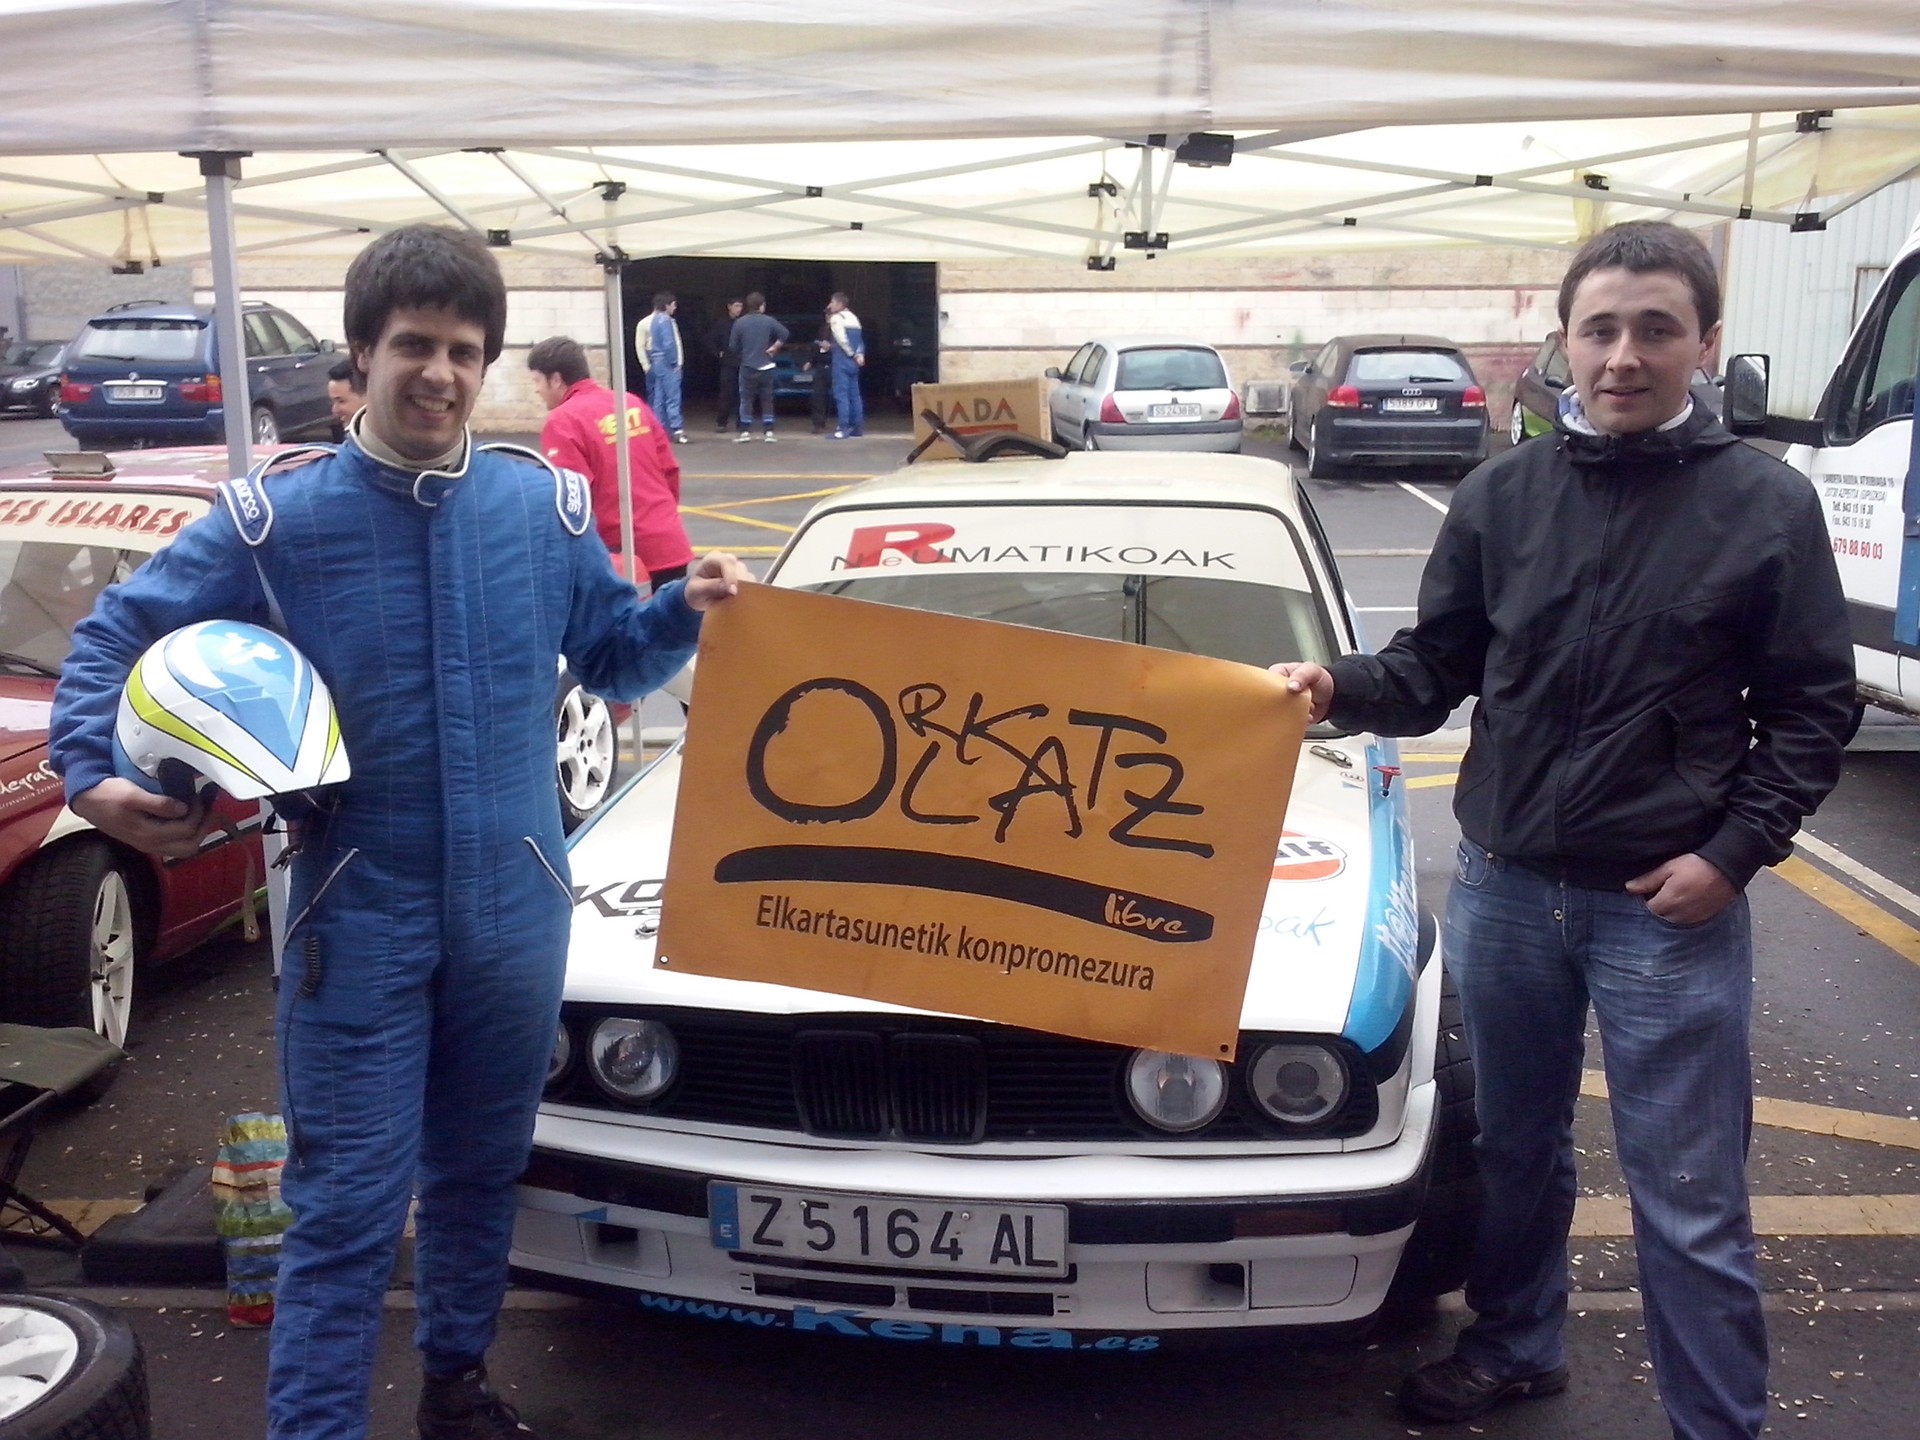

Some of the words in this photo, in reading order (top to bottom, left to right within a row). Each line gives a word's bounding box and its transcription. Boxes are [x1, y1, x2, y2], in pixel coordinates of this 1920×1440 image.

[46, 500, 191, 537] ISLARES
[231, 478, 260, 520] parco
[1833, 537, 1847, 554] 679
[1849, 539, 1858, 556] 88
[1861, 541, 1870, 558] 60
[1872, 543, 1883, 560] 03
[1103, 893, 1190, 935] libre
[755, 894, 952, 957] Elkartasunetik
[957, 925, 1155, 991] konpromezura
[750, 1195, 784, 1247] Z
[803, 1200, 963, 1262] 5164
[989, 1213, 1059, 1268] AL
